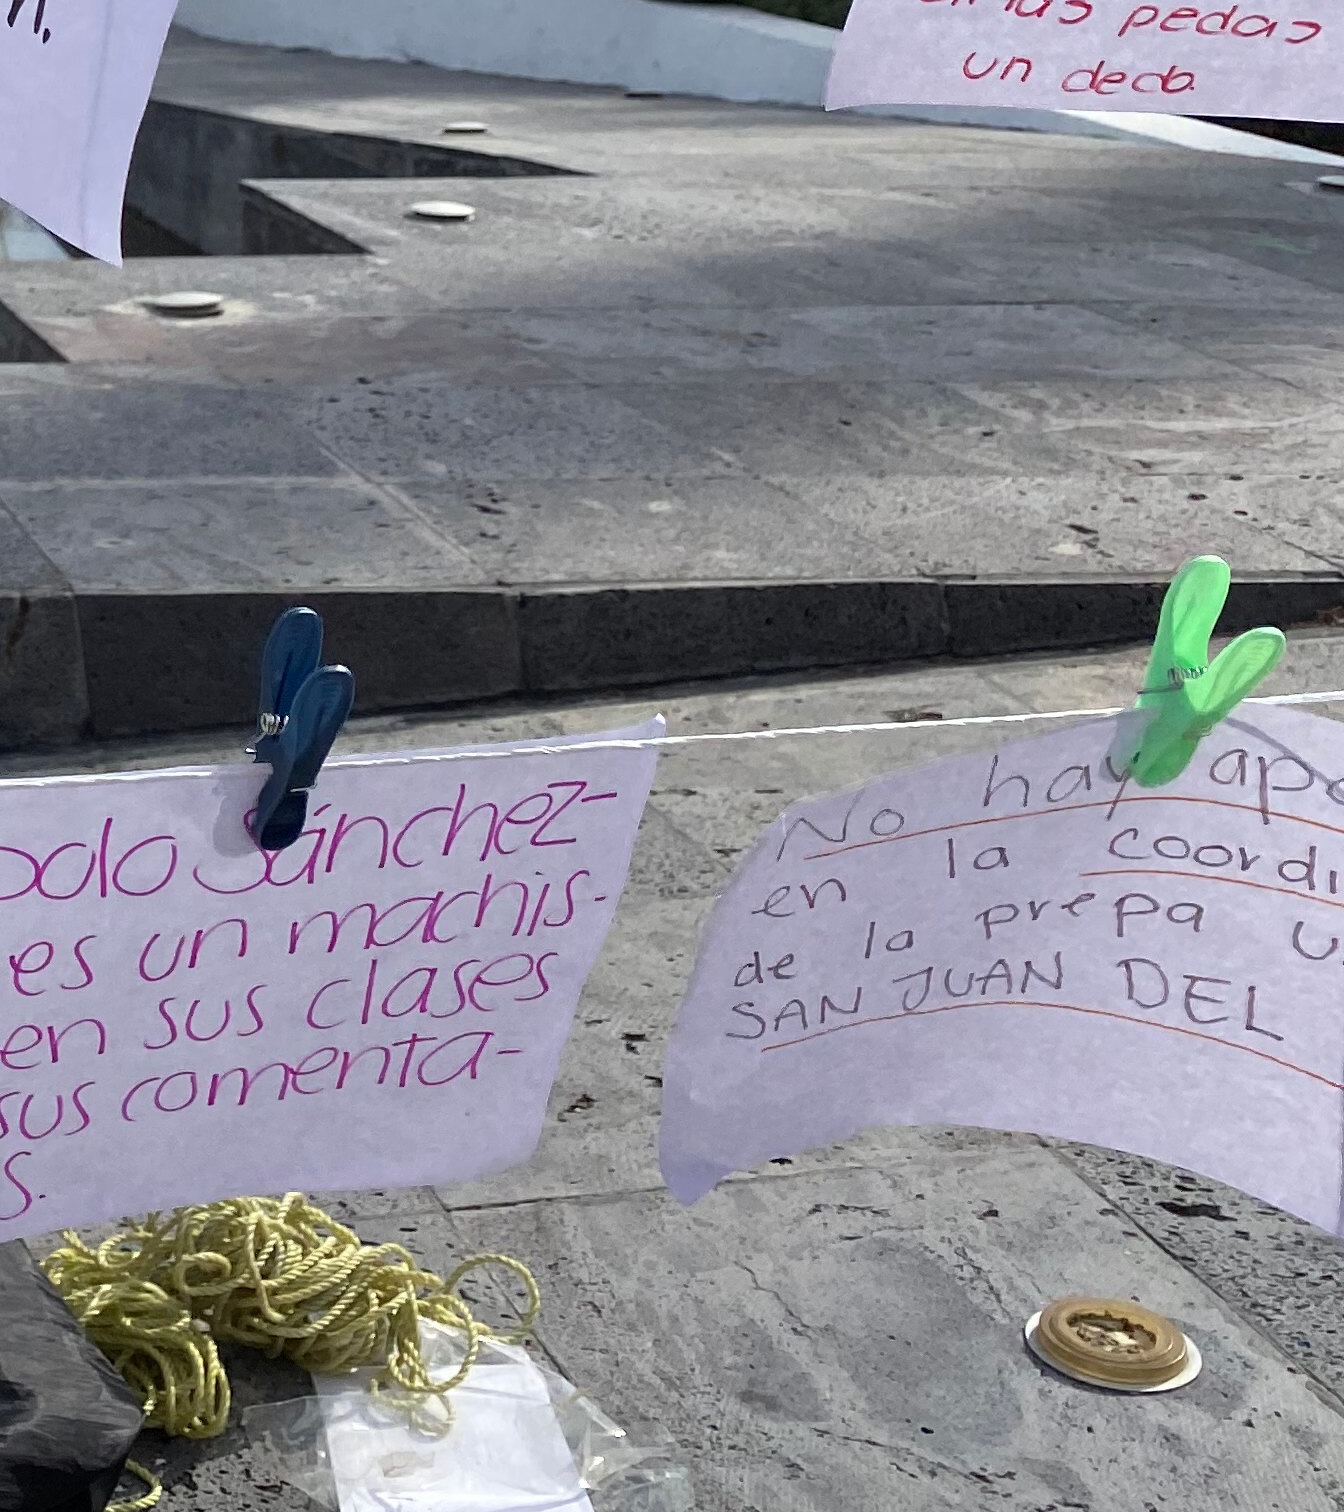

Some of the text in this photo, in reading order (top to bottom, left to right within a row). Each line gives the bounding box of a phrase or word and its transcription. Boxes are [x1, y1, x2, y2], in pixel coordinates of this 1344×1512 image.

[961, 51, 1033, 84] un
[1117, 4, 1323, 45] pedas
[776, 787, 907, 862] No
[983, 752, 1142, 822] hay
[750, 877, 848, 919] en
[946, 837, 1011, 879] la
[8, 934, 98, 996] es
[138, 917, 248, 982] un
[733, 949, 798, 988] de
[863, 920, 916, 960] la
[973, 891, 1206, 942] prepa
[143, 983, 269, 1050] sus
[305, 951, 560, 1030] clases
[724, 950, 1286, 1043] SAN JUAN DEL
[121, 1031, 525, 1123] comenta-
